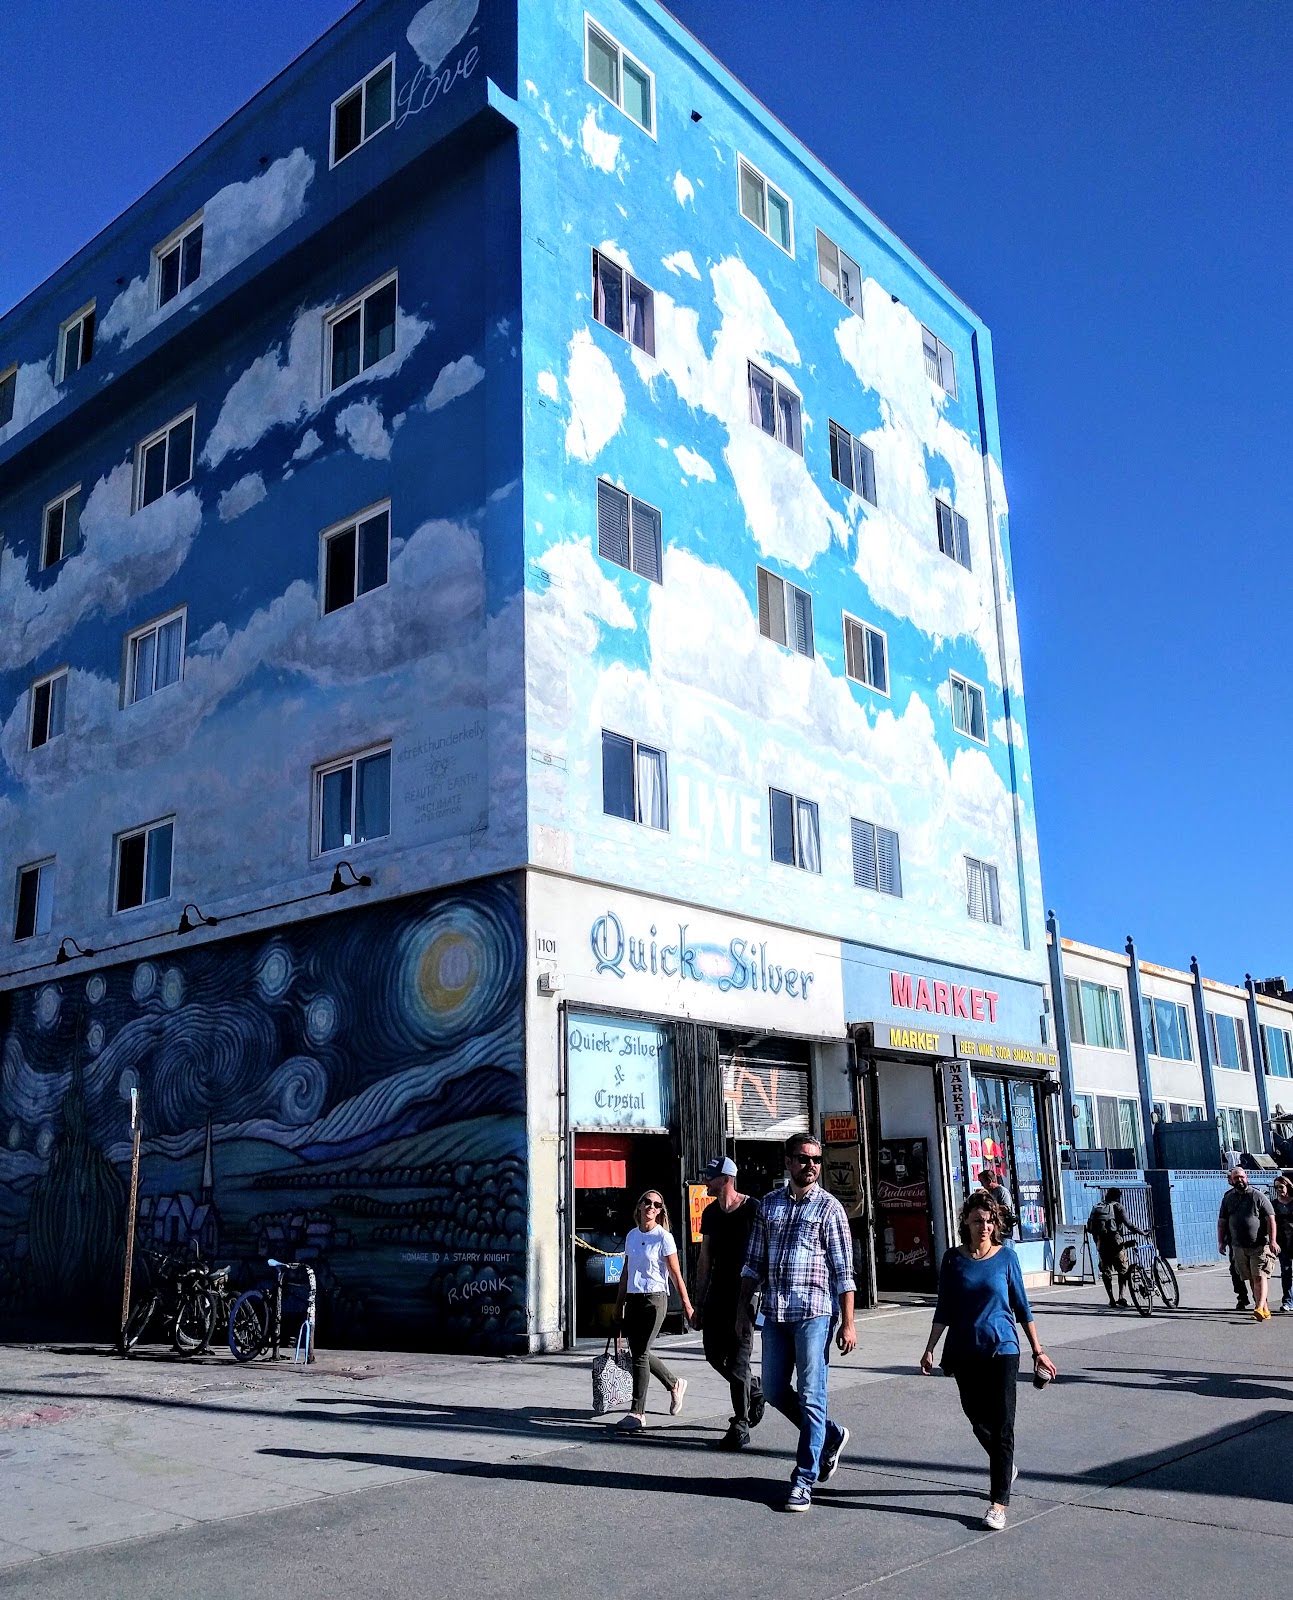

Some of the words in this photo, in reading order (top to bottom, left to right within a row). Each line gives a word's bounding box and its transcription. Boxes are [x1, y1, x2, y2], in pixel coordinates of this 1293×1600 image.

[395, 46, 480, 130] Love
[537, 938, 556, 953] 1101
[589, 910, 704, 982] Quick
[718, 937, 815, 1000] Silver
[890, 972, 999, 1024] MARKET
[569, 1029, 613, 1053] Quick
[618, 1035, 662, 1057] Silver
[890, 1028, 940, 1052] MARKET
[960, 1041, 976, 1055] BEER
[977, 1043, 993, 1057] WINE
[995, 1046, 1010, 1060] SODA
[1013, 1049, 1033, 1063] SNACKS
[1036, 1053, 1046, 1065] ATM
[614, 1065, 625, 1082] &
[594, 1089, 645, 1112] Crystal
[949, 1065, 965, 1122] MARKET
[830, 1118, 851, 1129] BODY
[1014, 1107, 1030, 1117] BUD
[826, 1128, 857, 1141] PIERCING
[432, 1252, 440, 1262] TO
[444, 1253, 450, 1261] A
[453, 1252, 481, 1262] STARRY
[481, 1305, 501, 1315] 1990
